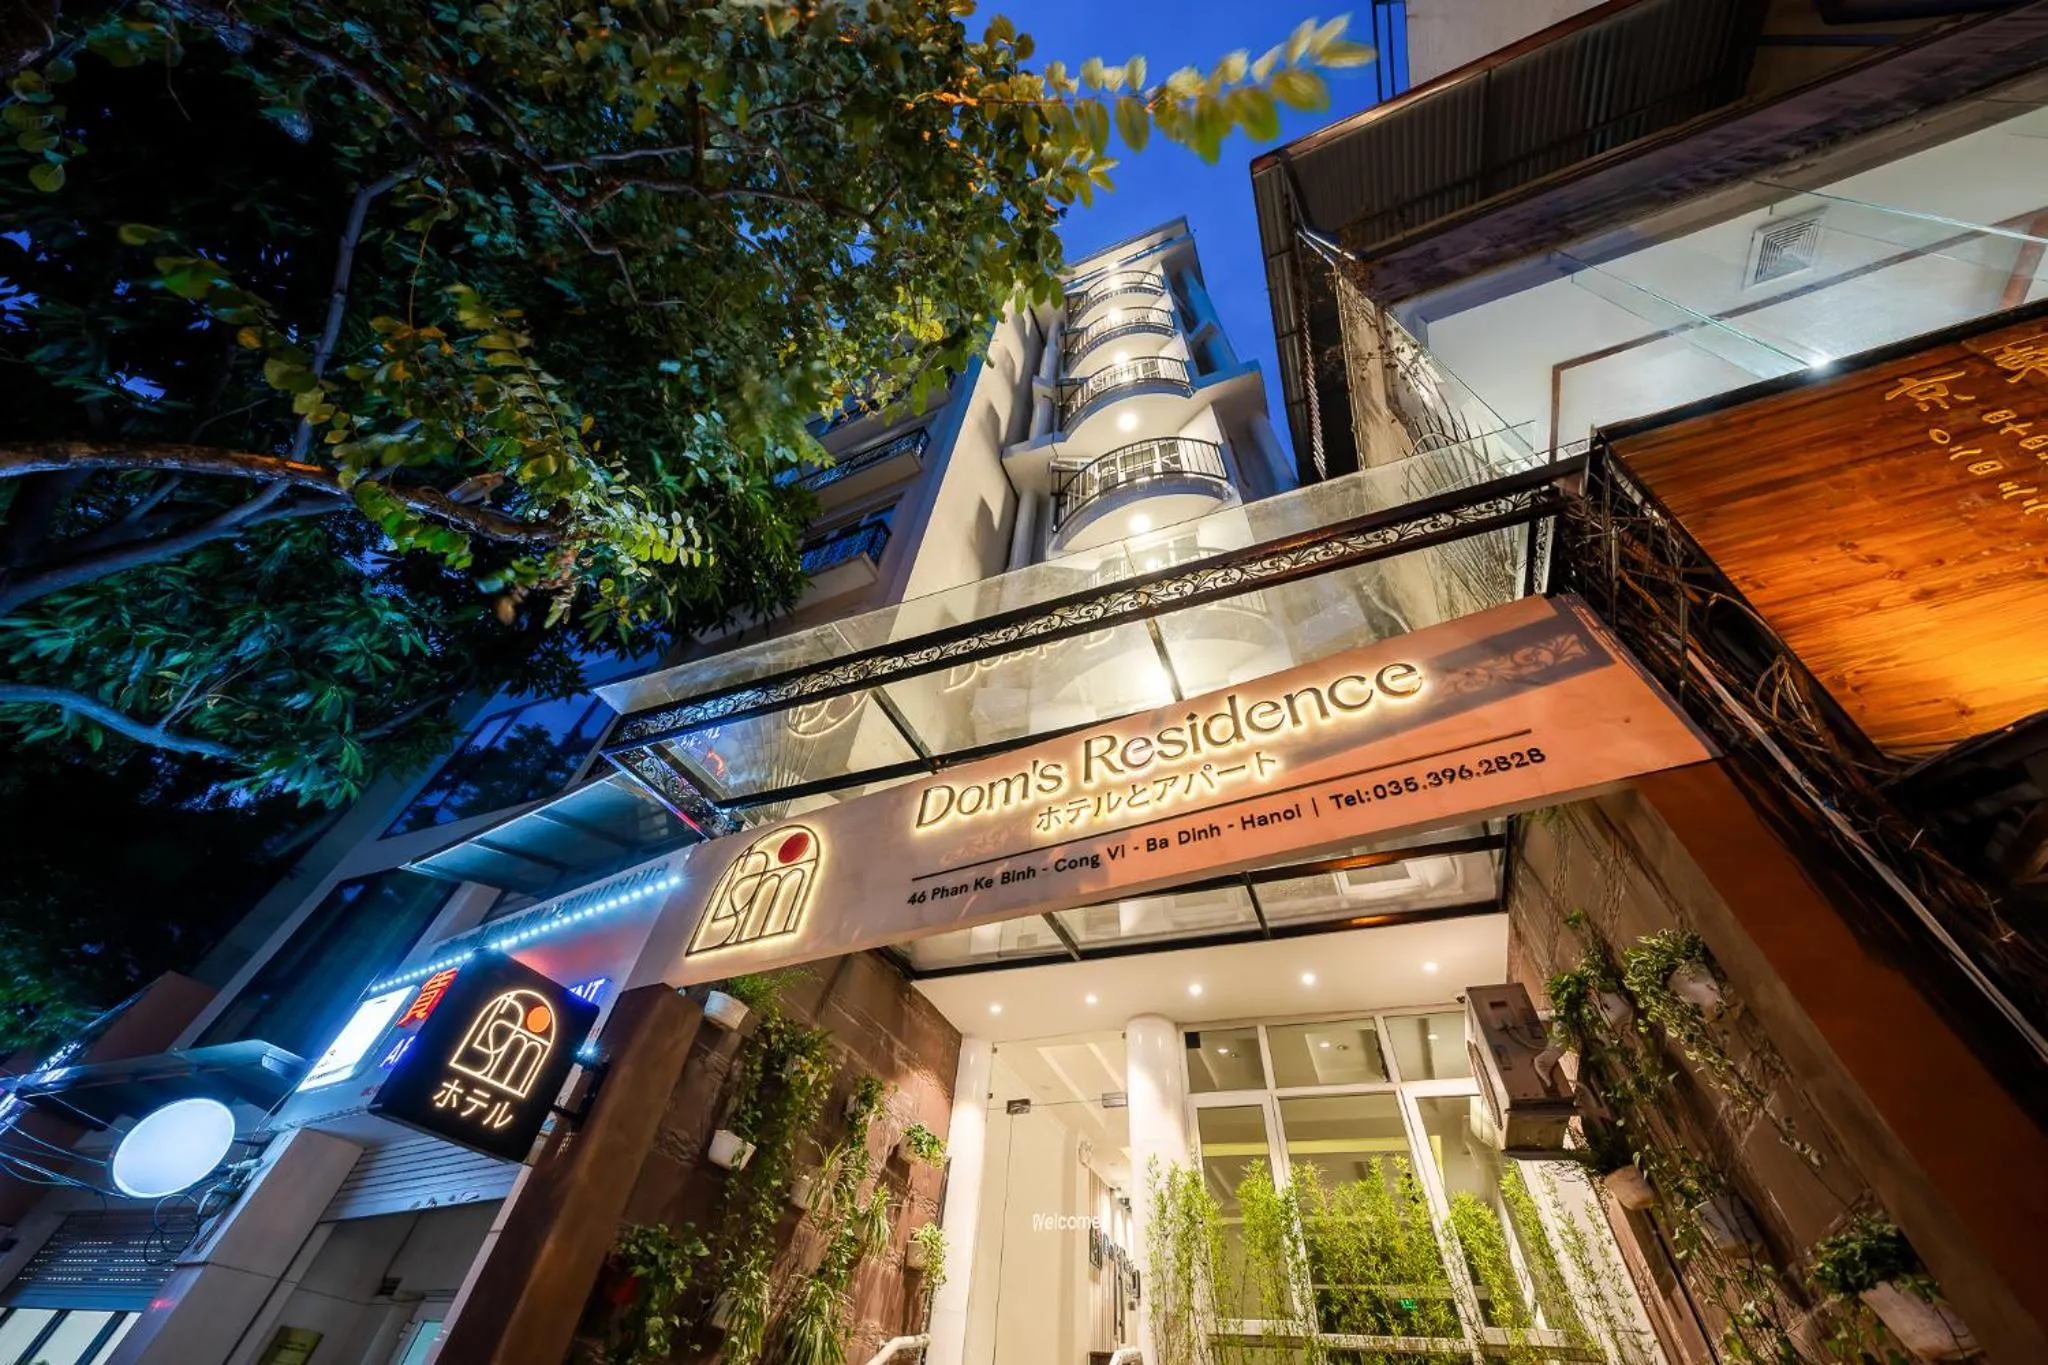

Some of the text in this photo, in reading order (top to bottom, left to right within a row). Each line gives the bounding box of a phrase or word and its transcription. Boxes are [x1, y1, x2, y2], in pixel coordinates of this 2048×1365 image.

[916, 760, 1063, 829] Dom's
[1083, 662, 1422, 783] Residence
[1036, 752, 1276, 832] ホテルとアパート
[907, 890, 926, 906] 46
[931, 883, 969, 901] Phan
[973, 876, 993, 891] Ke
[1000, 866, 1036, 885] Binh
[1054, 853, 1100, 874] Cong
[1107, 844, 1125, 860] Vi
[1146, 838, 1169, 852] Ba
[1177, 823, 1221, 845] Dinh
[1240, 803, 1301, 830] Hanoi
[432, 1079, 514, 1130] ホテル
[1032, 1212, 1100, 1231] Welcome
